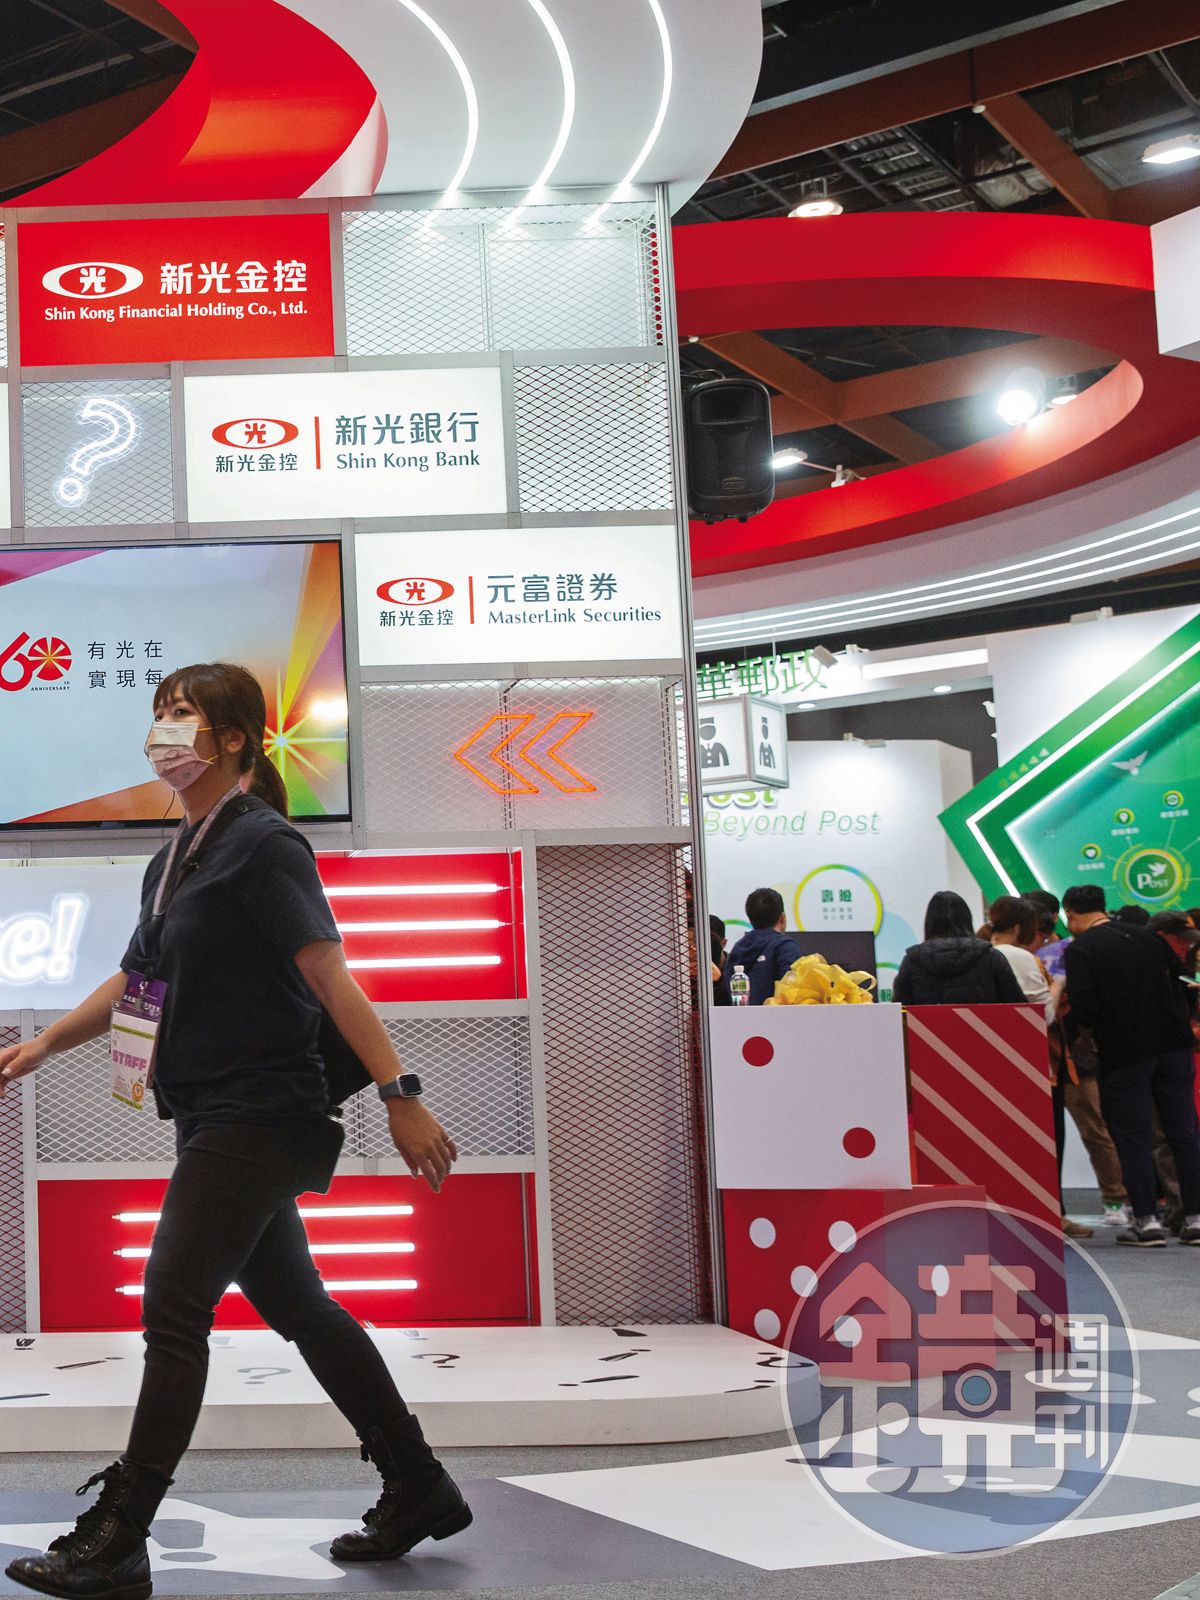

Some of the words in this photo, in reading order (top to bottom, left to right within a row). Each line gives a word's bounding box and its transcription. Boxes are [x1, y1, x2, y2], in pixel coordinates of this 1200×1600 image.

[79, 267, 108, 296] 光
[160, 260, 307, 294] 新光金控
[44, 306, 76, 321] Shin
[80, 306, 115, 323] Kong
[119, 304, 183, 319] Financial
[187, 302, 244, 320] Holding
[248, 303, 276, 317] Co.,
[281, 301, 308, 315] Ltd.
[244, 422, 266, 445] 光
[336, 412, 479, 446] 新光銀行
[216, 453, 297, 472] 新光金控
[336, 452, 377, 470] Shin
[384, 452, 429, 473] Kong
[437, 450, 480, 467] Bank
[405, 581, 426, 602] 光
[487, 573, 618, 604] 元富證券
[380, 609, 454, 627] 新光金控
[488, 608, 577, 624] MasterLink
[583, 606, 662, 623] Securities
[88, 639, 163, 660] 有光在
[88, 668, 180, 689] 實現每
[703, 810, 807, 840] Beyond
[818, 810, 881, 833] Post
[112, 1050, 147, 1071] STAFF
